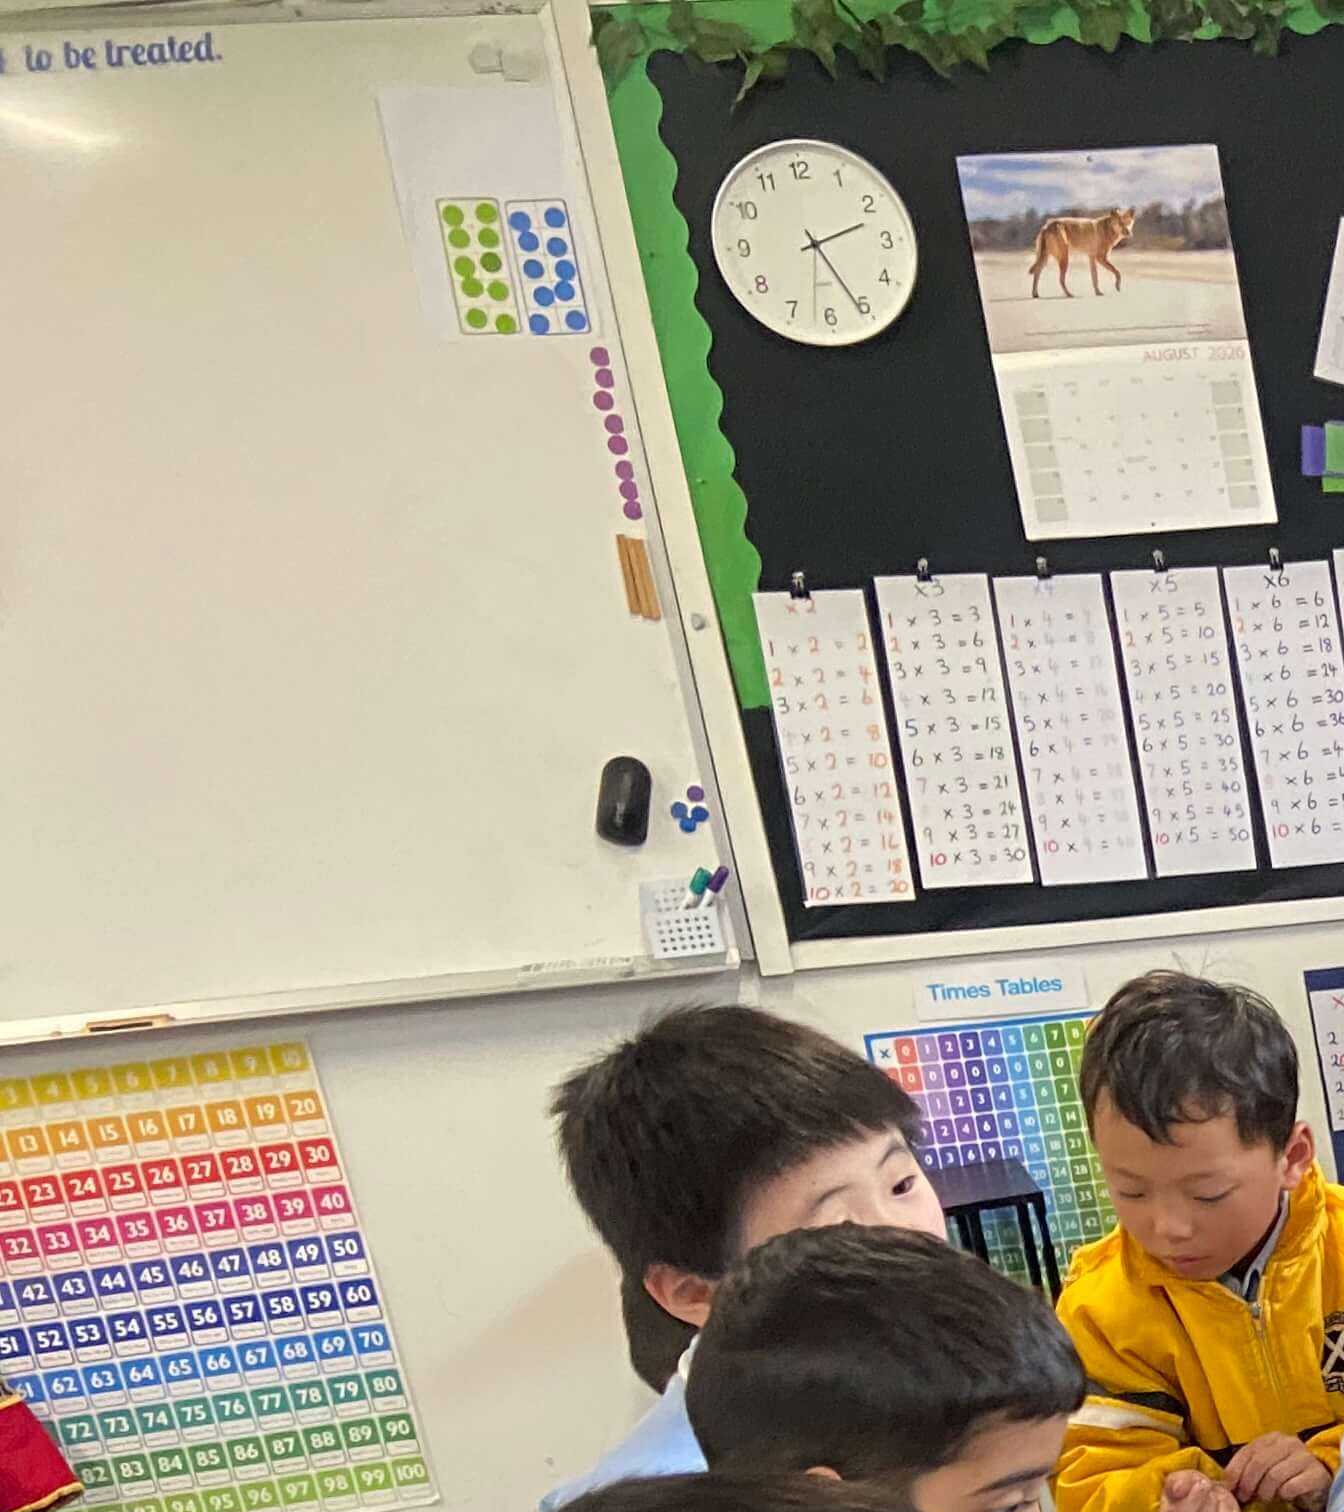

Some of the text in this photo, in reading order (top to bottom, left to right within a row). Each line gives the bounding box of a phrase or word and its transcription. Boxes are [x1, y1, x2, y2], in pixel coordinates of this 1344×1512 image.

[25, 45, 51, 72] to
[63, 41, 96, 69] be
[105, 32, 223, 67] treated.
[790, 161, 811, 180] 12
[833, 169, 843, 187] 1
[757, 173, 775, 191] 11
[736, 201, 758, 220] 10
[862, 194, 876, 213] 2
[737, 239, 751, 257] 9
[880, 231, 893, 249] 3
[755, 275, 768, 293] 8
[878, 268, 890, 286] 4
[785, 300, 798, 318] 7
[858, 296, 871, 315] 5
[824, 308, 837, 326] 6
[1143, 348, 1200, 362] AUGUST
[928, 609, 942, 626] 3
[968, 605, 981, 622] 3
[1162, 626, 1174, 645] 5
[1199, 625, 1215, 640] 10
[1240, 643, 1252, 661] 3
[1278, 640, 1289, 655] 6
[1320, 637, 1333, 653] 18
[926, 976, 1063, 1002] Times Tables
[1328, 1031, 1338, 1045] 2
[18, 1098, 317, 1153] 13 14 15 16 17 18 19 20
[29, 1145, 330, 1202] 23 24 25 26 27 28 29 30
[5, 1192, 345, 1255] 32 33 34 35 36 37 38 39 40
[22, 1238, 359, 1301] 42 43 44 45 46 47 48 49 50
[0, 1285, 372, 1354] 51 52 53 54 55 56 57 58 59 60
[51, 1376, 78, 1394] 62
[90, 1370, 115, 1389] 63
[129, 1364, 155, 1383] 64
[168, 1358, 193, 1377] 65
[206, 1353, 231, 1371] 66
[244, 1347, 267, 1365] 67
[283, 1341, 309, 1360] 68
[321, 1336, 346, 1354] 69
[358, 1330, 384, 1348] 70
[65, 1375, 398, 1439] 72 73 74 75 76 77 78 79 80
[80, 1419, 410, 1484] 82 83 84 85 86 87 88 89 90
[209, 1493, 234, 1511] 95
[247, 1487, 273, 1505] 96
[285, 1480, 309, 1499] 97
[323, 1474, 349, 1492] 98
[361, 1469, 385, 1486] 99
[396, 1463, 426, 1481] 100
